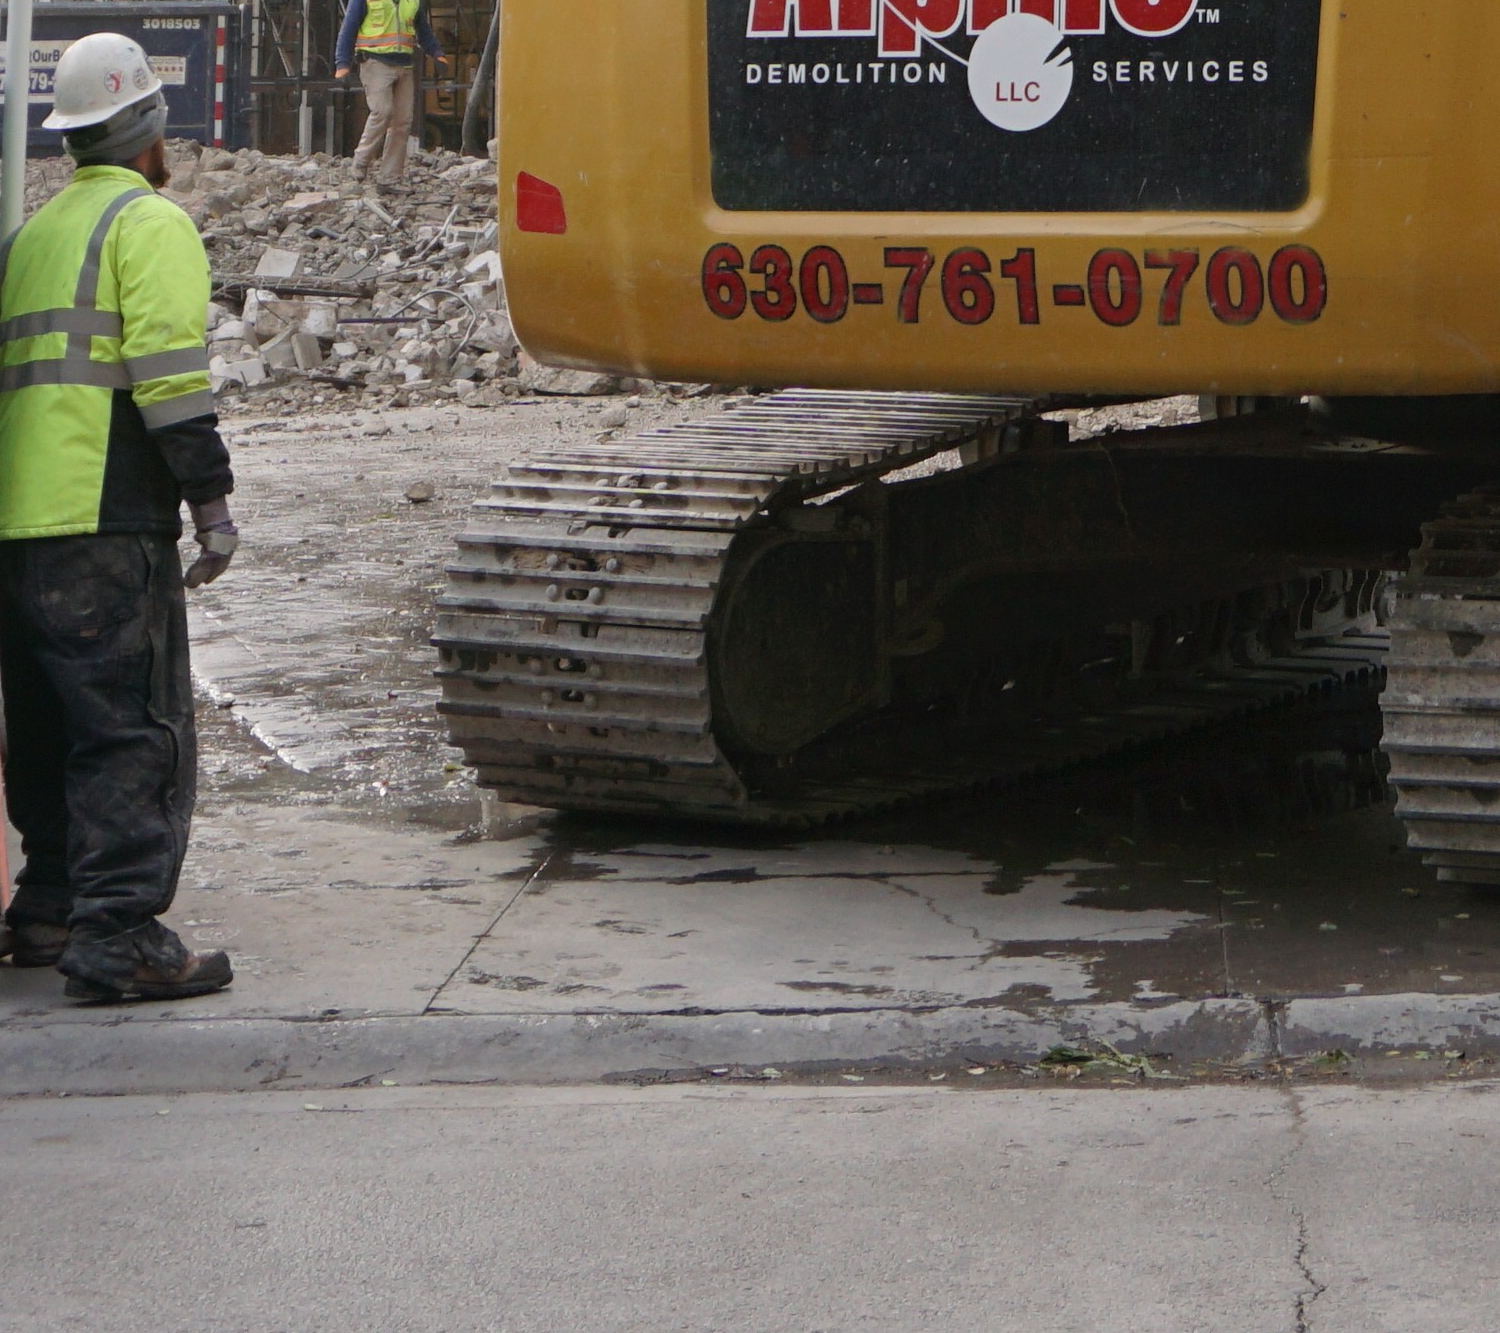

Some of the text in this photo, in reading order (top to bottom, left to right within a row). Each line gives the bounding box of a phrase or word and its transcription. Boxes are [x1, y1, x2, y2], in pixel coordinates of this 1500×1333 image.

[142, 18, 200, 30] 3018503
[746, 61, 1268, 84] DEMOLITION SERVICES
[996, 82, 1040, 102] LLC
[701, 242, 1328, 327] 630-761-0700
